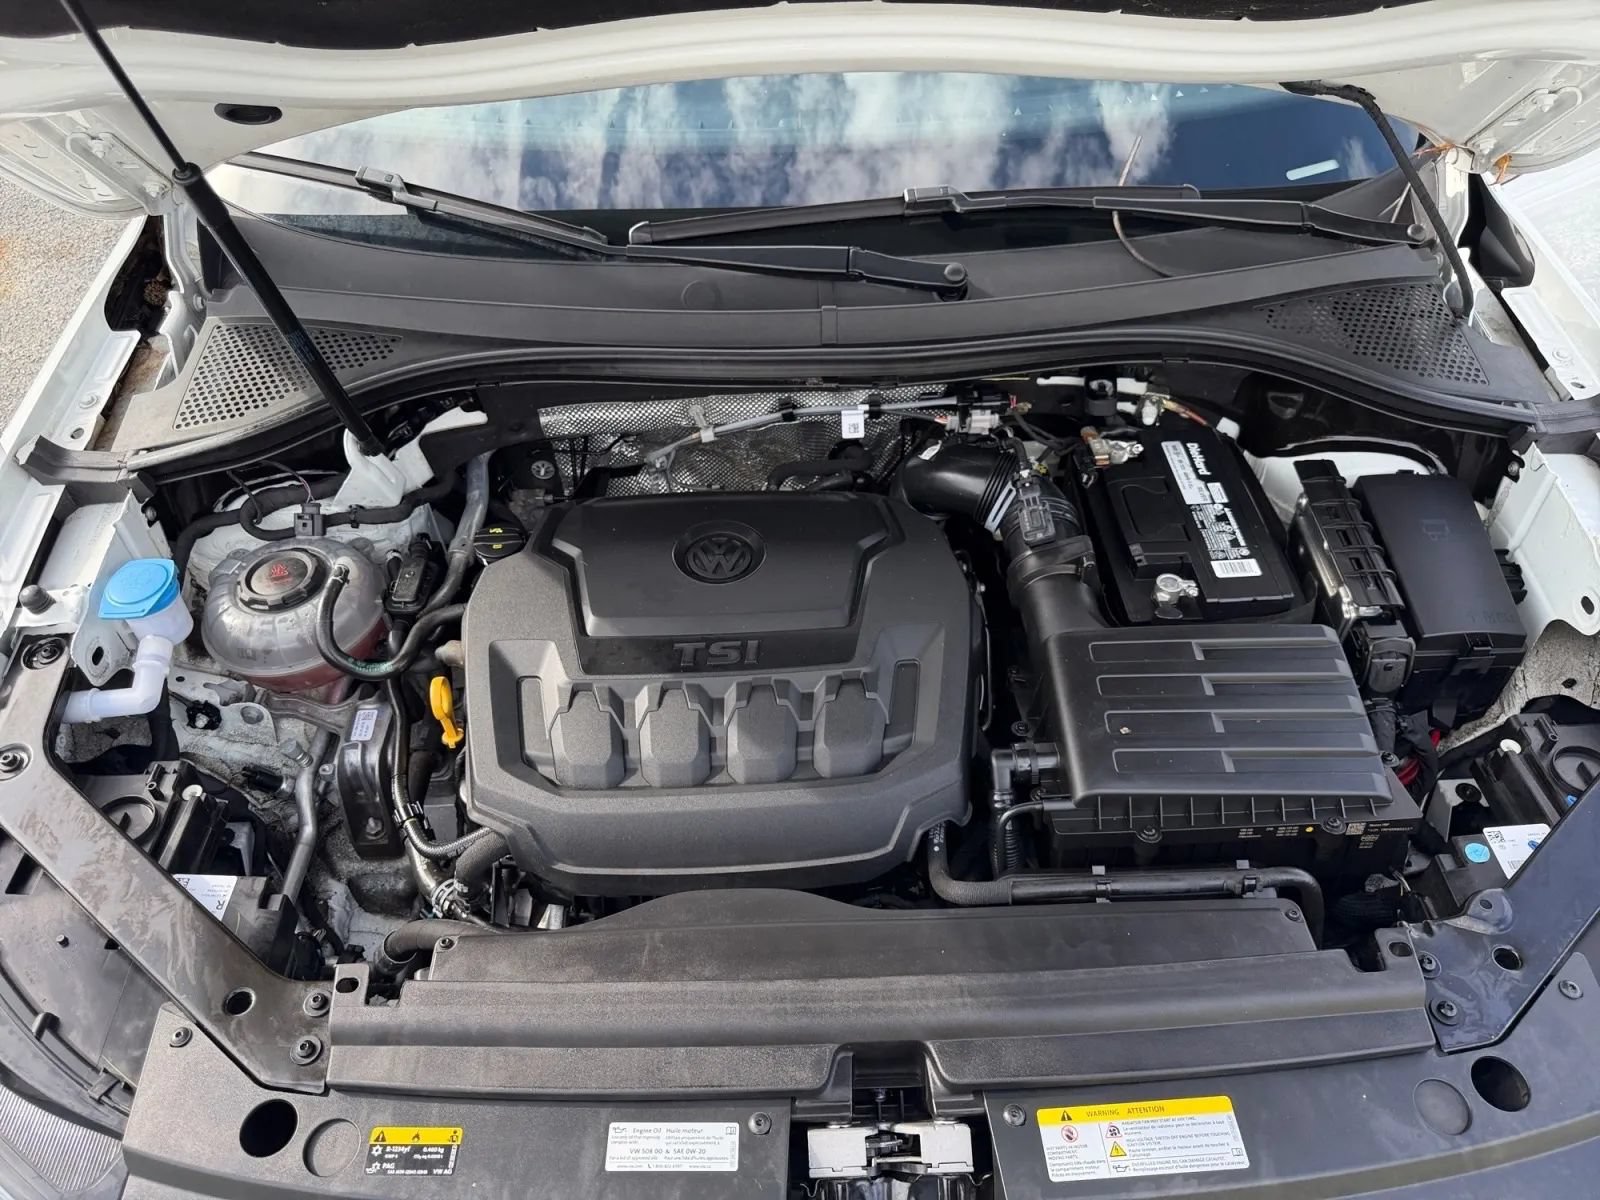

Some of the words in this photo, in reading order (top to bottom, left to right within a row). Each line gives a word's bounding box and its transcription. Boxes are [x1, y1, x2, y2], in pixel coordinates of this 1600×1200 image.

[1186, 442, 1212, 475] DieHard
[673, 640, 758, 666] TSI
[1086, 1109, 1120, 1118] WARNING
[1127, 1106, 1165, 1115] ATTENTION
[632, 1127, 652, 1135] Engine
